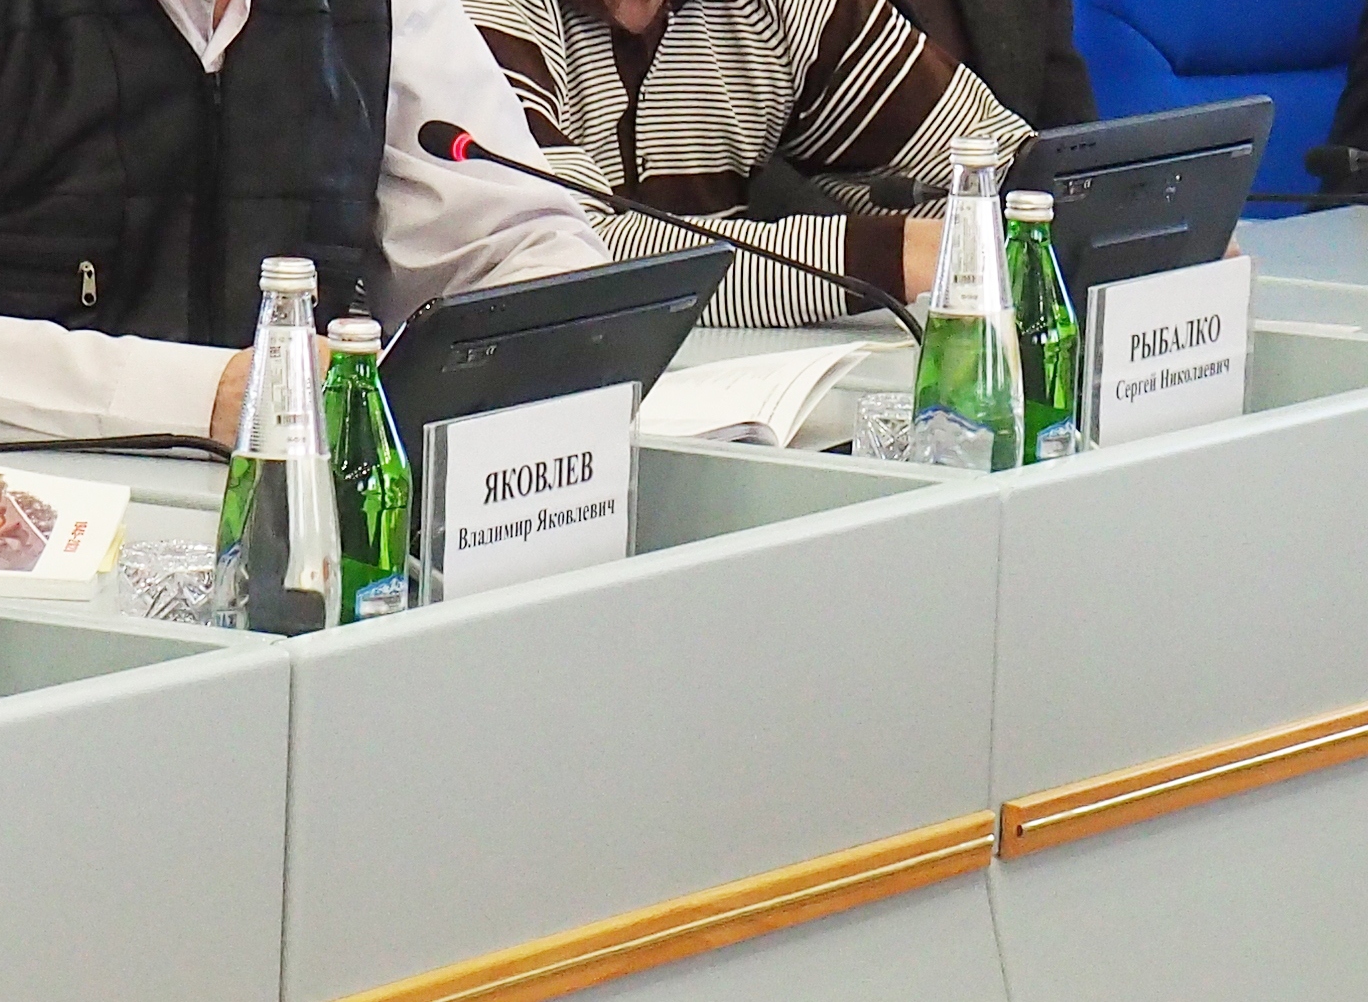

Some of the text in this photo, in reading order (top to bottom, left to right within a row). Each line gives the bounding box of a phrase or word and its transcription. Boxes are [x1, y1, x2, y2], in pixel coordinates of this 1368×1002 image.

[1129, 314, 1221, 363] РЫБАЛКО
[1115, 358, 1230, 403] Сергей Николаевич
[483, 451, 594, 505] ЯКОВЛЕВ
[458, 499, 616, 550] Владимир Яковлевич
